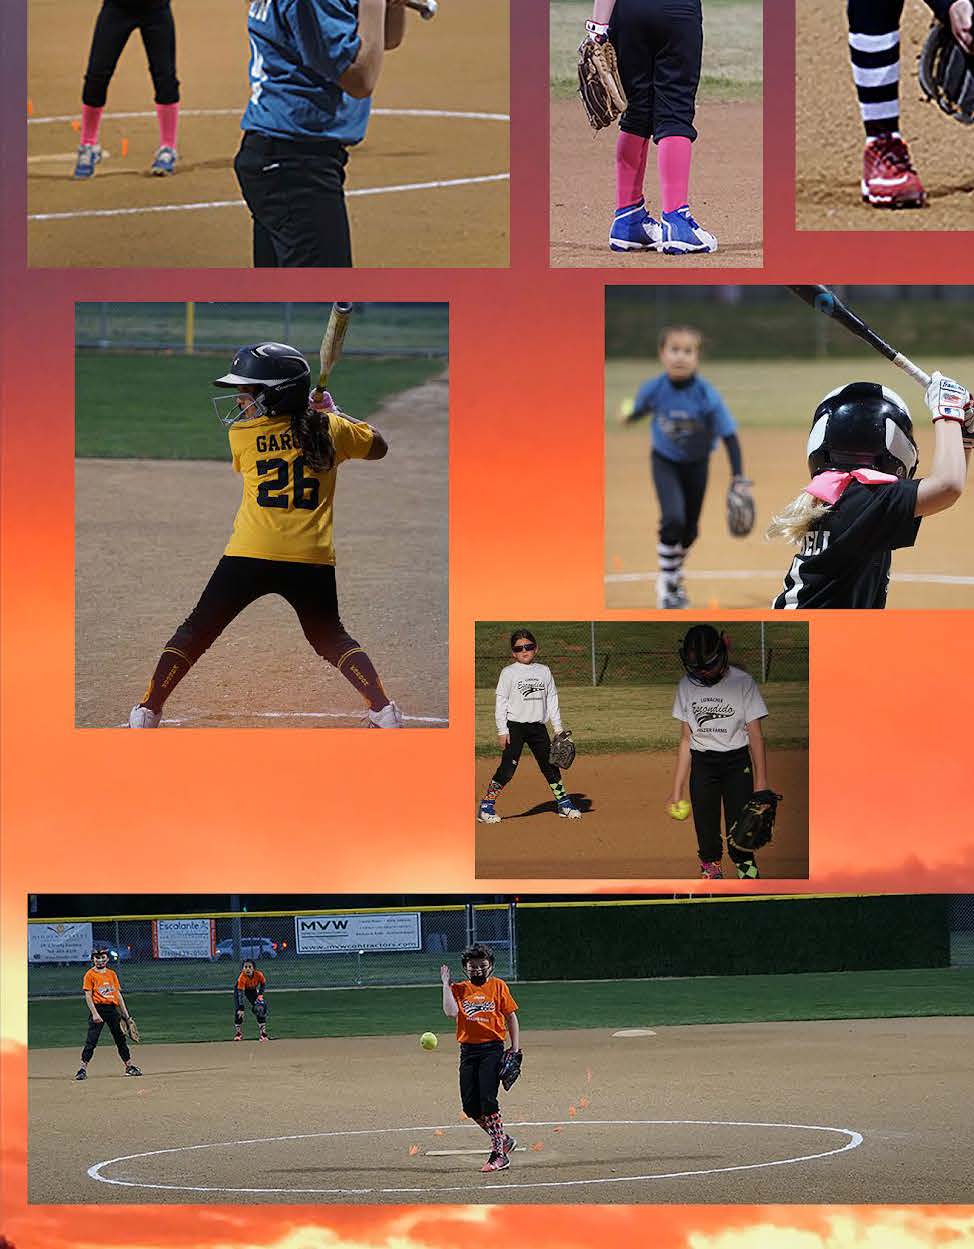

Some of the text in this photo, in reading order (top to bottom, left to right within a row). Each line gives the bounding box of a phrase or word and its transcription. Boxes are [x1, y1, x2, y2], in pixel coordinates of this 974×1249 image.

[255, 457, 321, 511] 26
[692, 702, 735, 715] Escondido
[159, 920, 200, 931] Escalante
[301, 919, 349, 931] MVW
